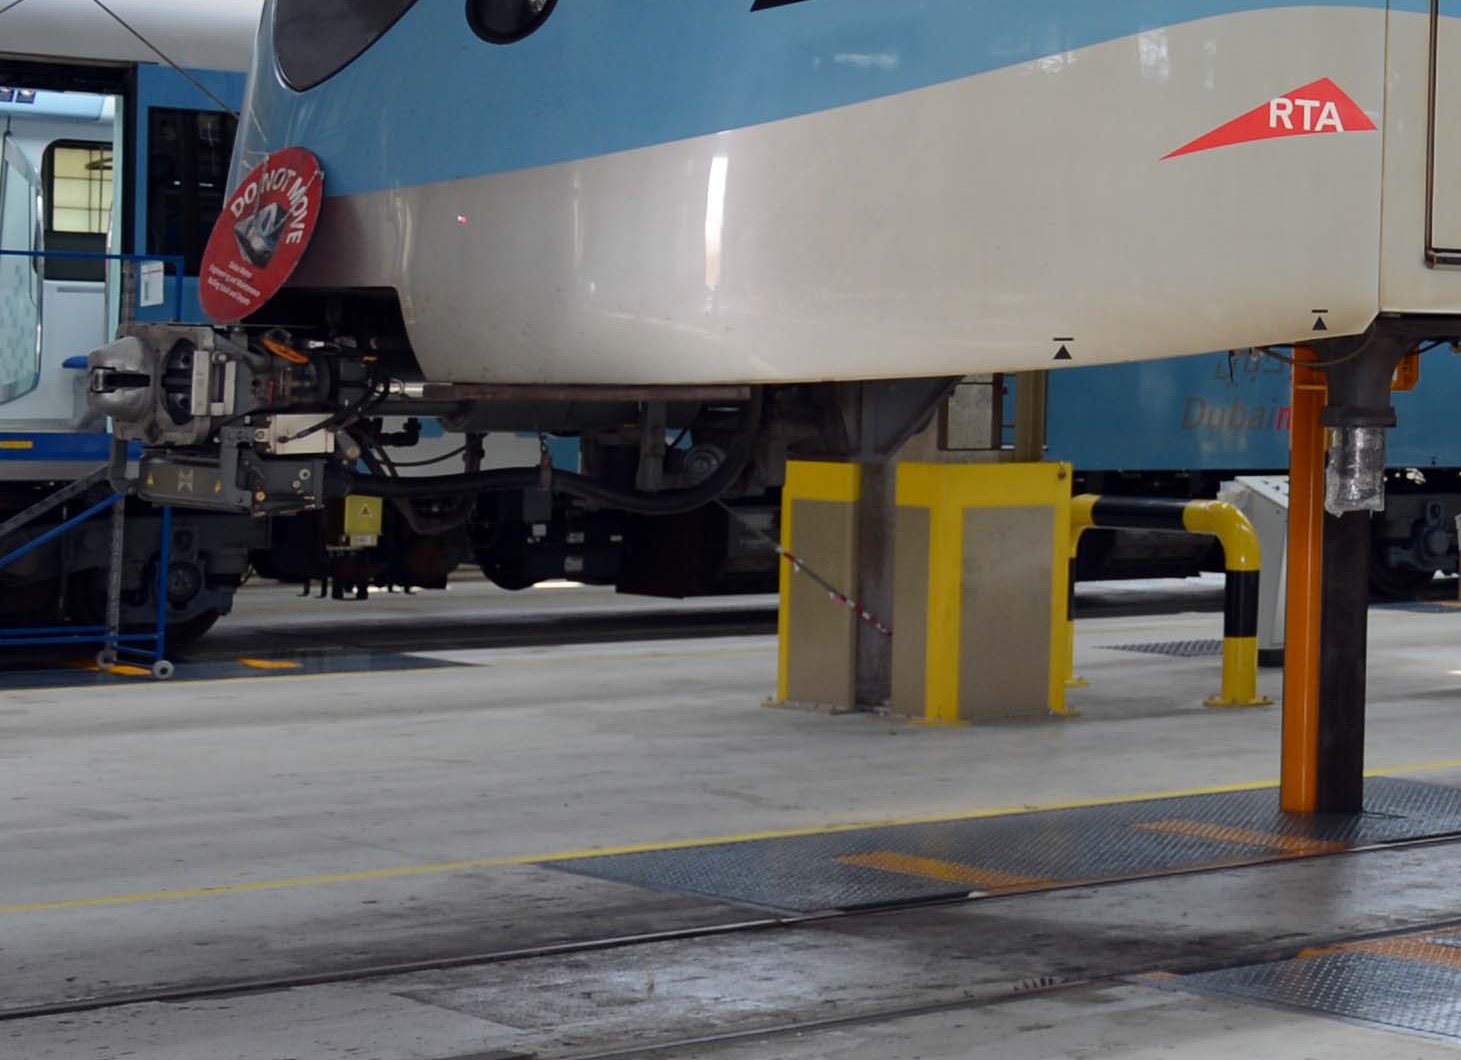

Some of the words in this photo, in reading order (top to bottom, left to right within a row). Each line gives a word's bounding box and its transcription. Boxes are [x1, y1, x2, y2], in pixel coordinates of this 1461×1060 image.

[1269, 98, 1344, 132] RTA
[231, 182, 258, 218] DO
[261, 167, 296, 194] NOT
[286, 176, 310, 244] MOVE
